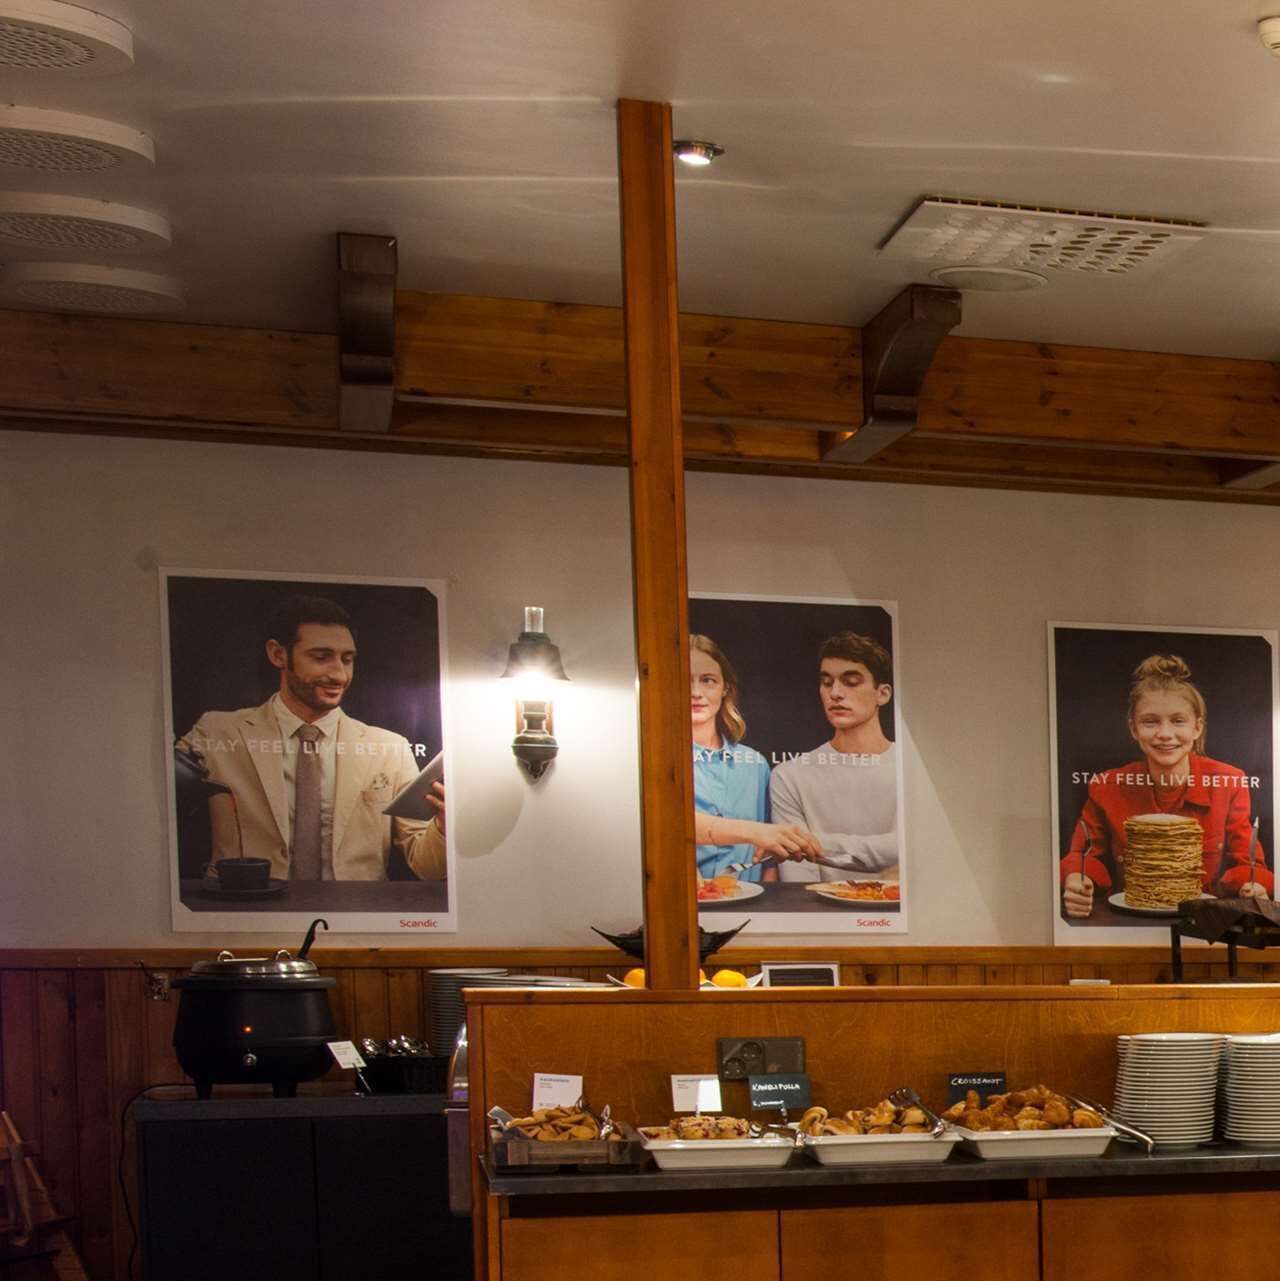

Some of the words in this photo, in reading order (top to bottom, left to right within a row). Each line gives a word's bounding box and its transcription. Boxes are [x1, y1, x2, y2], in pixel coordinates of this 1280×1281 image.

[193, 738, 236, 752] STAY
[248, 739, 292, 754] FEEL
[303, 740, 345, 755] LIVE
[355, 741, 427, 757] BETTER
[694, 750, 713, 763] AY
[722, 751, 764, 764] FEEL
[772, 752, 811, 765] LIVE
[818, 753, 881, 766] BETTER
[1072, 771, 1109, 784] STAY
[1116, 772, 1154, 786] FEEL
[1160, 774, 1196, 787] LIVE
[1203, 775, 1260, 788] BETTER
[399, 919, 439, 928] Scandic
[856, 918, 892, 927] Scandic
